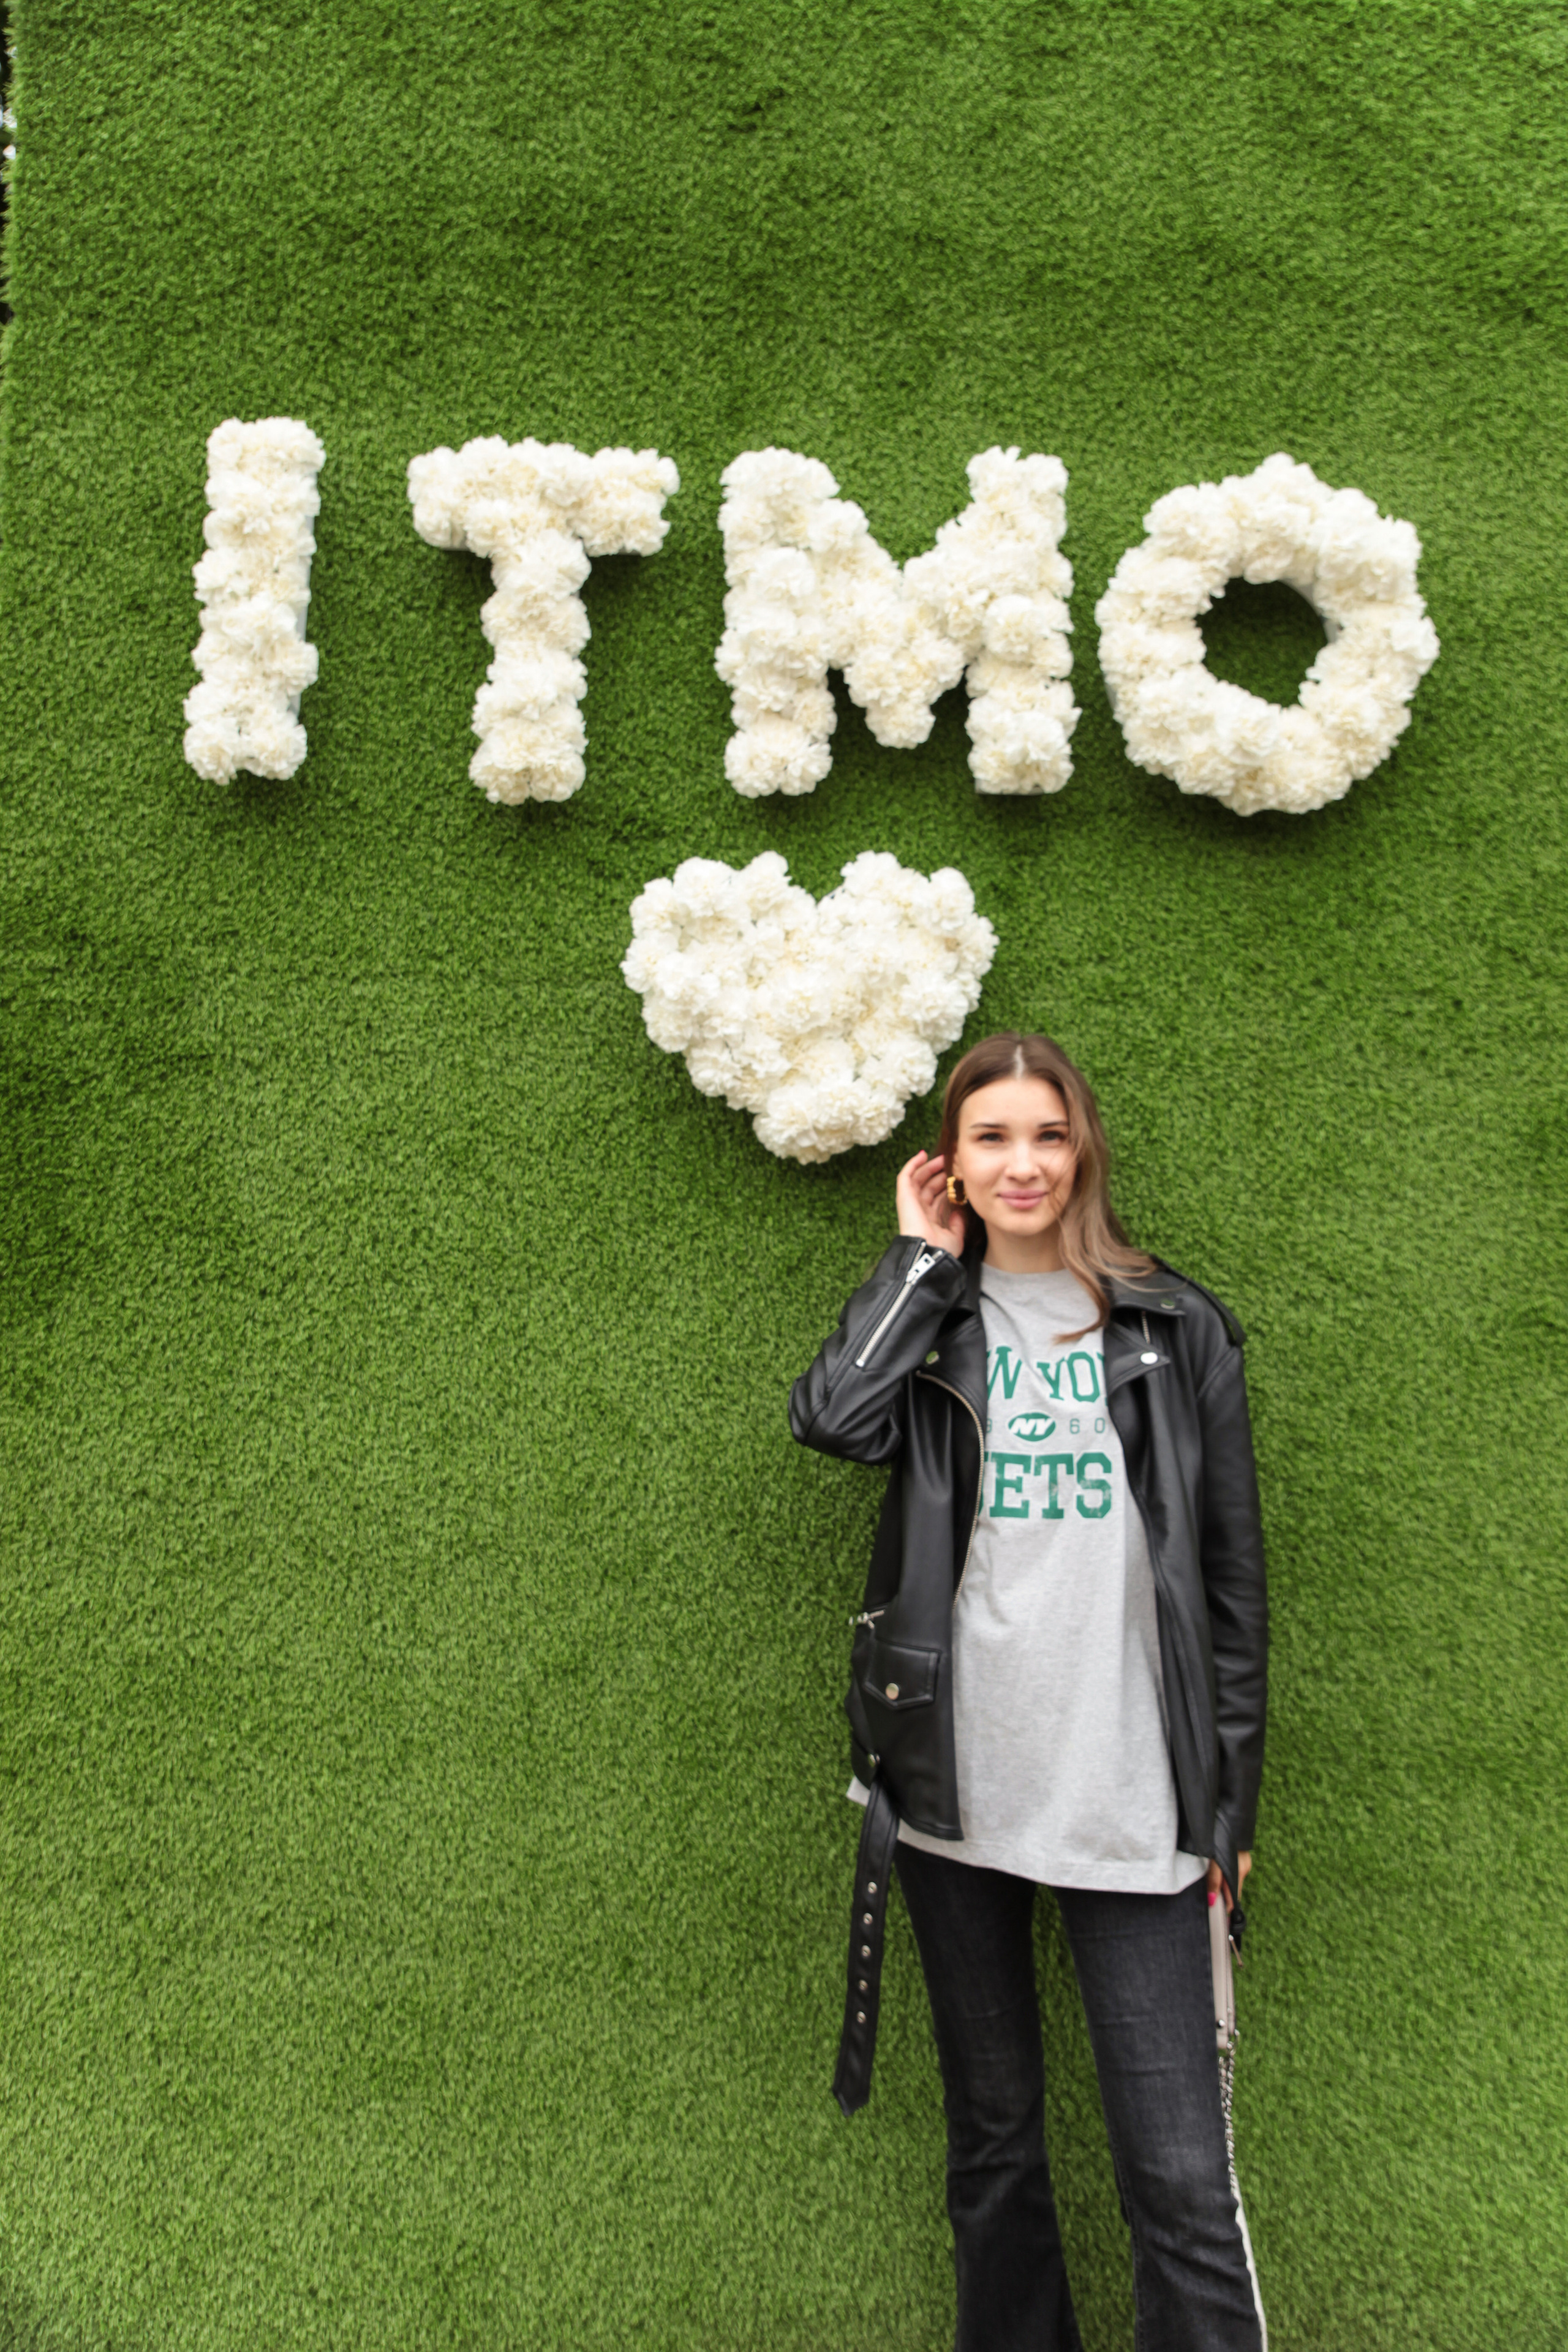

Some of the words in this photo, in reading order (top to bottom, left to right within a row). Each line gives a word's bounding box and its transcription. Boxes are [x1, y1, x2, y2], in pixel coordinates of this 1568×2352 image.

[183, 415, 1440, 816] ITMO
[1036, 1351, 1107, 1407] YO
[1010, 1417, 1054, 1436] NY
[979, 1452, 1112, 1520] ETS
